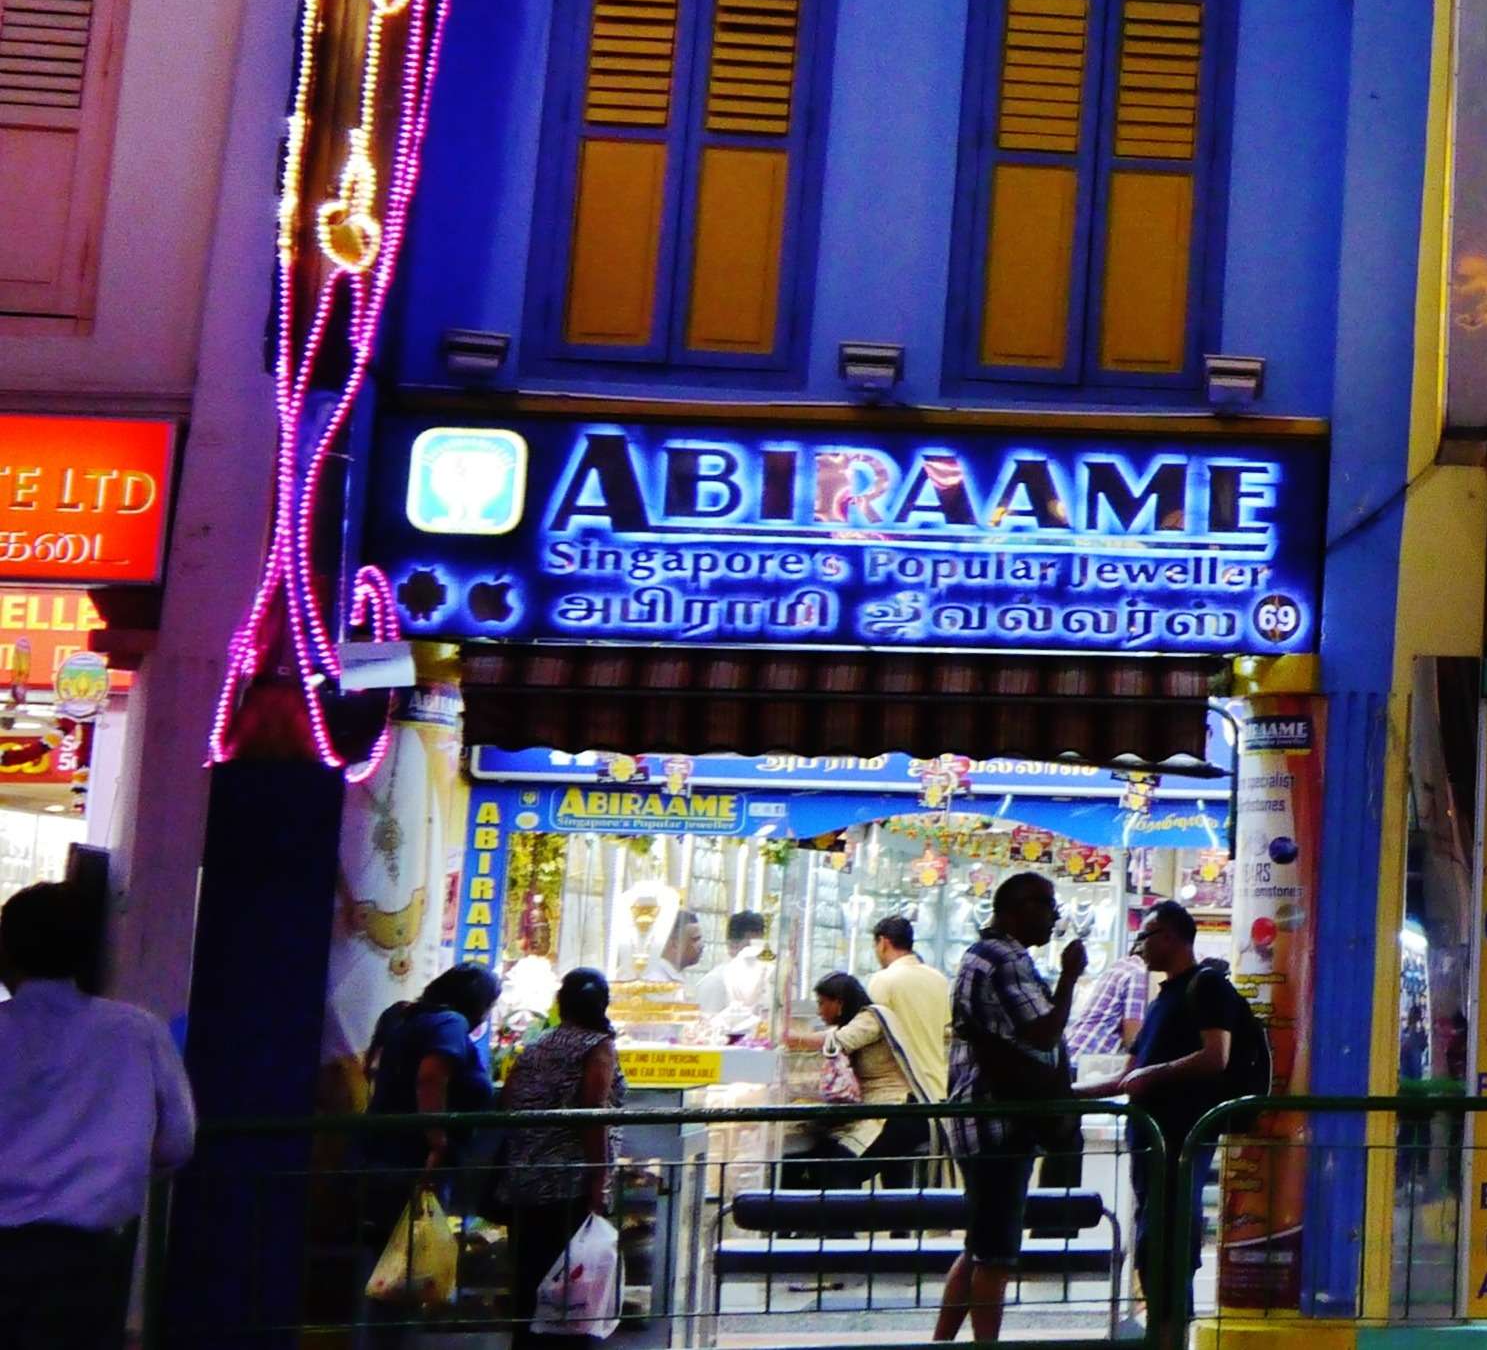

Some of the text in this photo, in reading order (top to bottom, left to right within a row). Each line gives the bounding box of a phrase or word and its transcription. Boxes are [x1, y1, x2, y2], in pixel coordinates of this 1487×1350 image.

[56, 467, 157, 515] LTD
[547, 432, 1271, 535] ABIRAAME
[548, 540, 1270, 590] Singapore's Popular Jeweller
[555, 586, 831, 635] அபிராமி
[1257, 603, 1297, 631] 69
[557, 787, 738, 818] ABIRAAME
